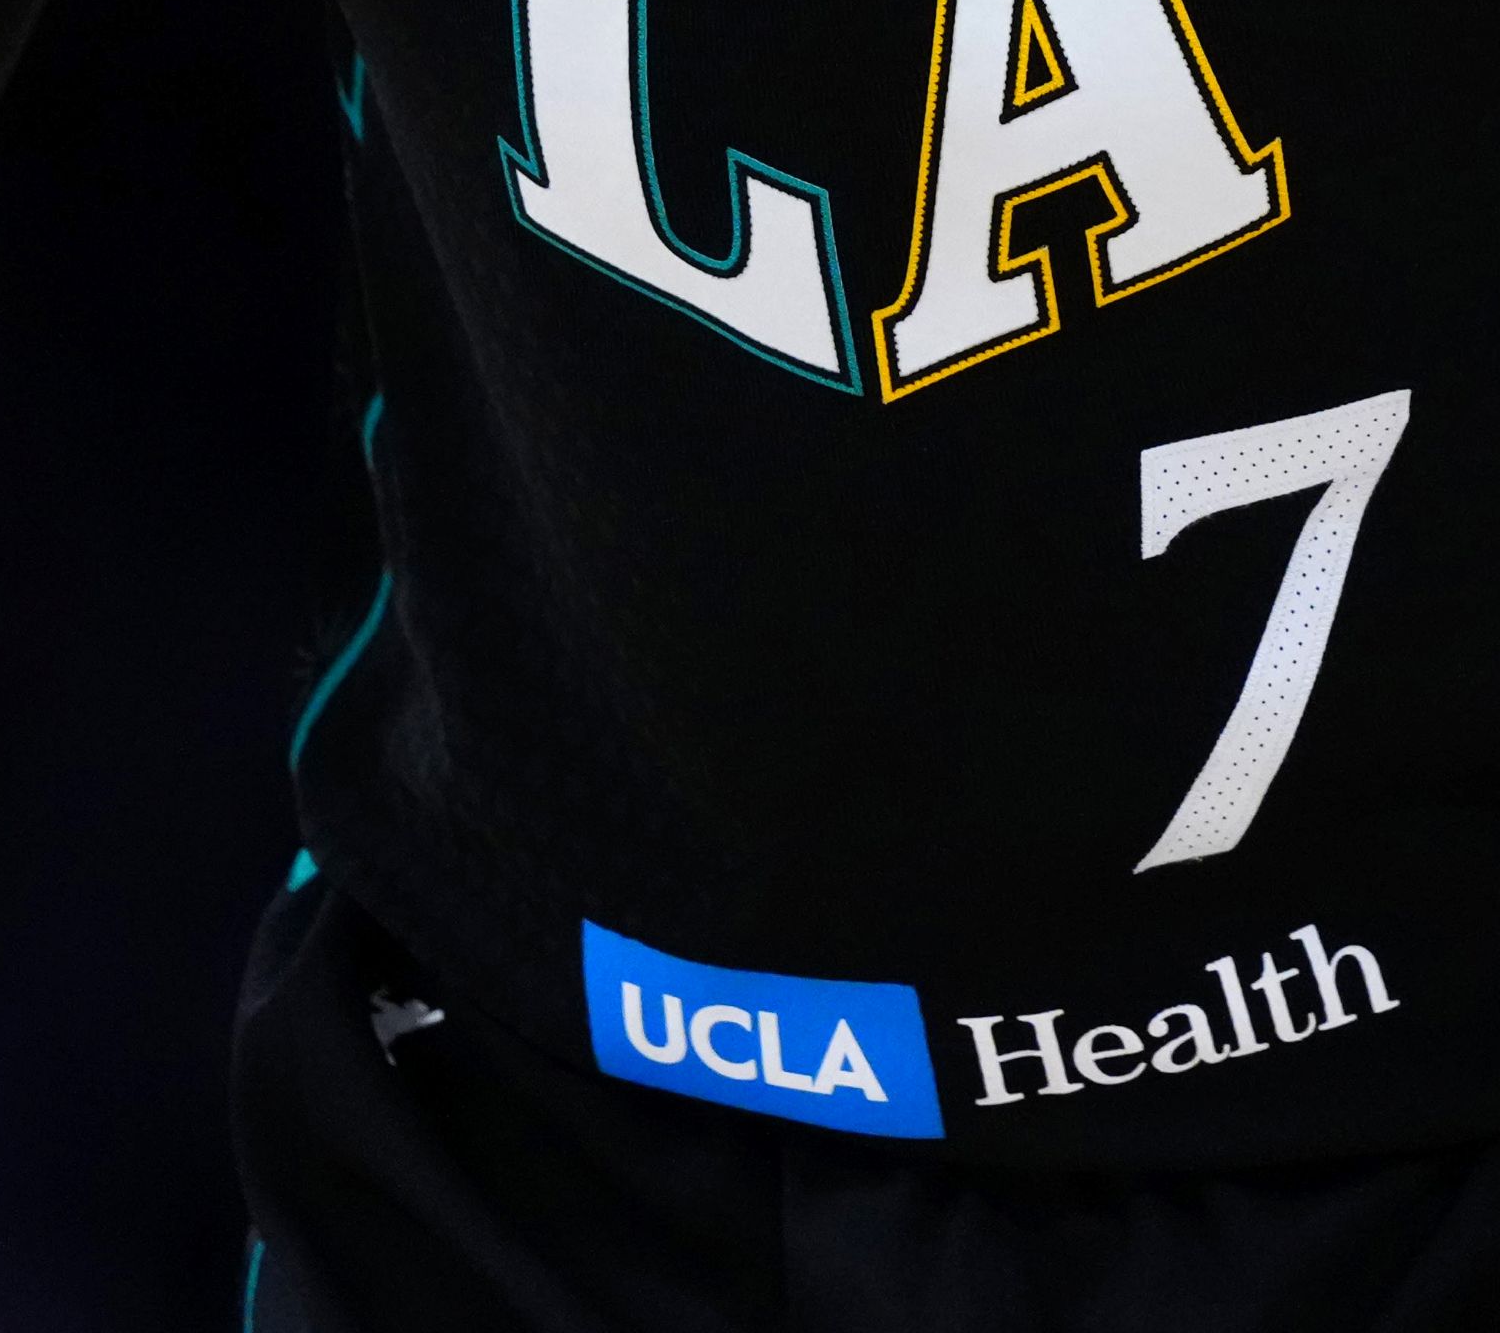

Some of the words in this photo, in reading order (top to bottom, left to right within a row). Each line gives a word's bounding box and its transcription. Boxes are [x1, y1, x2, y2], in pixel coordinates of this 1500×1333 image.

[1132, 388, 1412, 875] 7
[621, 981, 889, 1102] UCLA
[956, 924, 1400, 1106] Health
